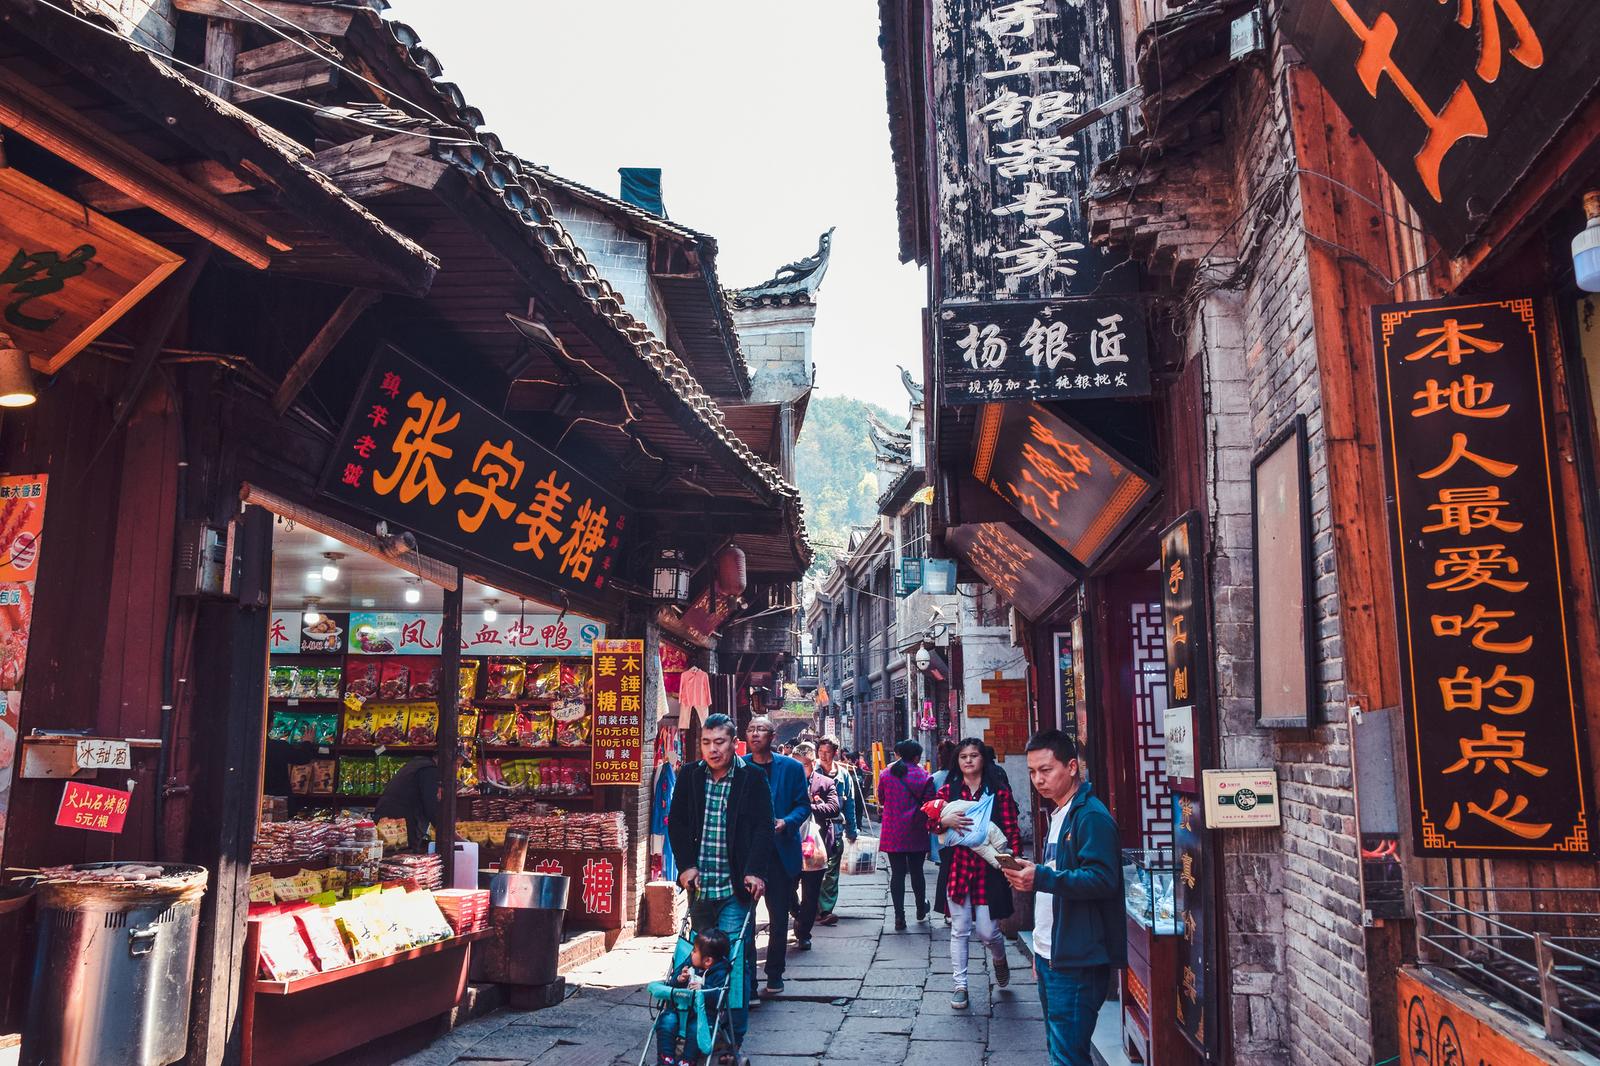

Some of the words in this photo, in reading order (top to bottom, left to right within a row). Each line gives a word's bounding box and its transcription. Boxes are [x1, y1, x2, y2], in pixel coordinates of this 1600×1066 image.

[956, 313, 1129, 370] 杨银匠
[968, 379, 1041, 394] 现场加工
[1055, 372, 1129, 389] 纯银批发
[372, 391, 609, 582] 张字姜糖
[1404, 318, 1553, 839] 本地人最爱吃的点心
[597, 655, 617, 712] 姜糖
[597, 715, 639, 725] 简装任选
[595, 726, 640, 737] 50元8包
[596, 737, 640, 748] 100元16包
[595, 760, 639, 770] 50元6包
[595, 771, 639, 782] 100元12包
[65, 787, 128, 815] 火山石烤肠
[74, 811, 110, 828] 5元/根
